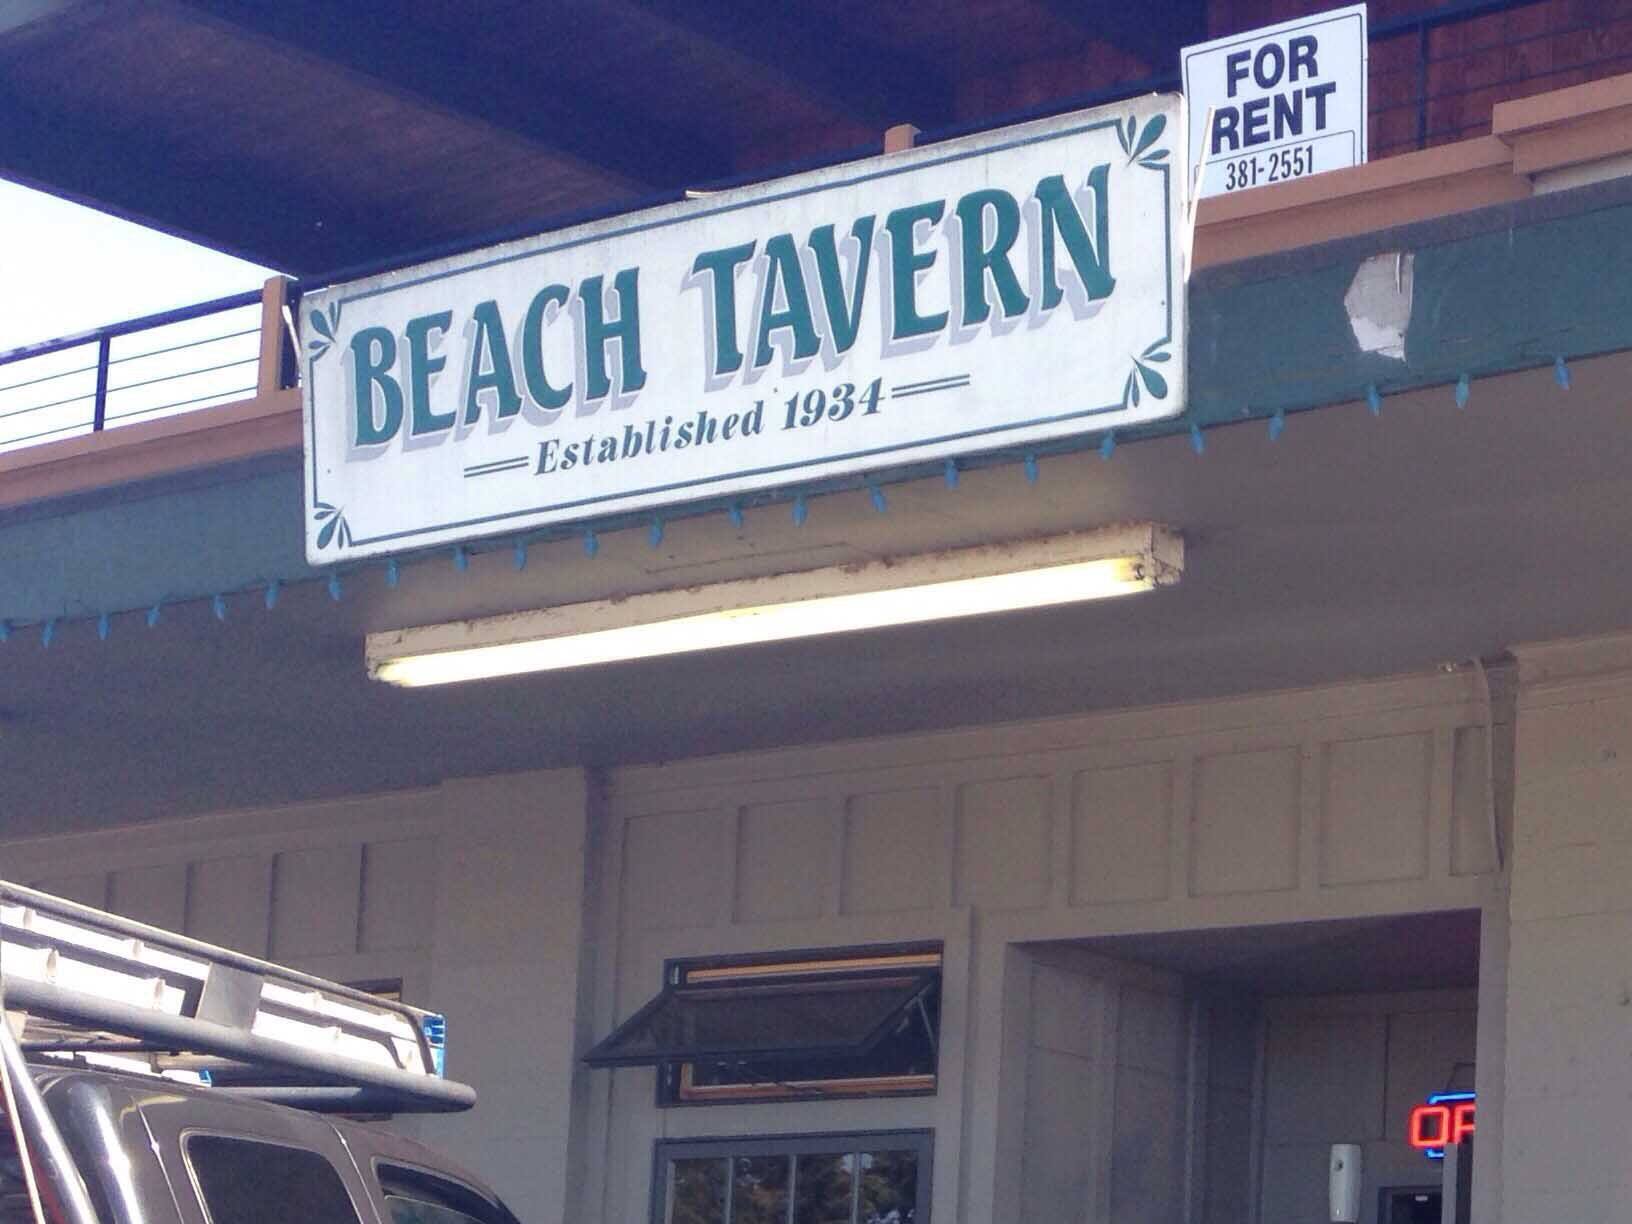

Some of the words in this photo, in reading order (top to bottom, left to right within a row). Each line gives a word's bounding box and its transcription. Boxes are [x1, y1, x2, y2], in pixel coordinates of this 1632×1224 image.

[1227, 34, 1319, 99] FOR
[1211, 80, 1337, 156] RENT
[1225, 144, 1314, 191] 381-2551
[347, 266, 649, 449] BEACH
[692, 162, 1118, 376] TAVERN
[534, 403, 764, 477] Established
[782, 377, 886, 432] 1934
[1410, 1103, 1477, 1149] OP
